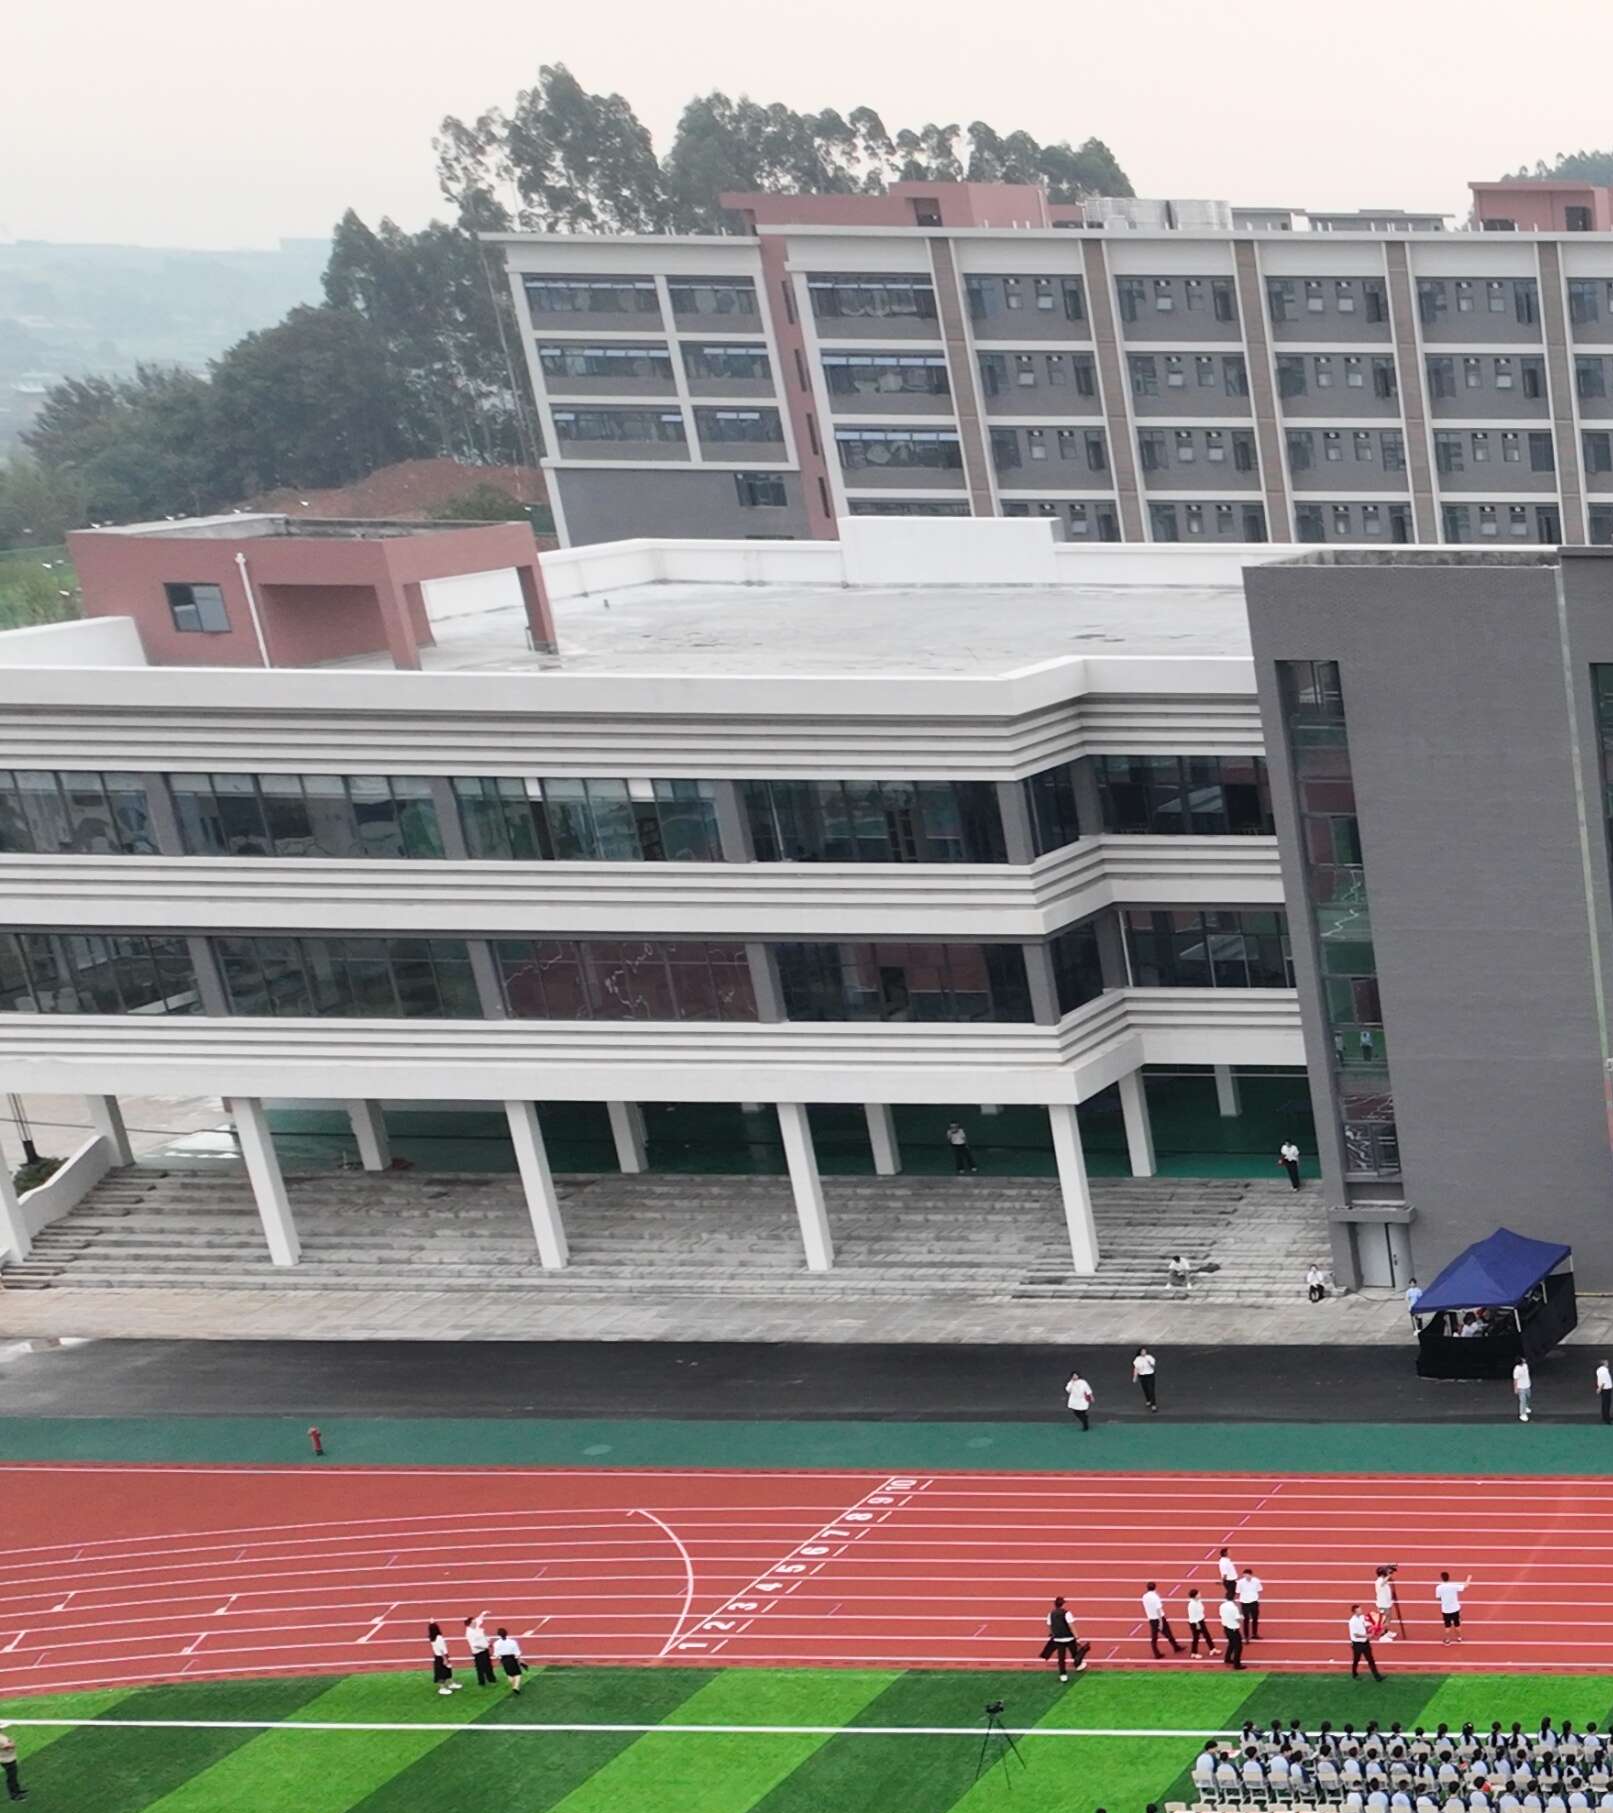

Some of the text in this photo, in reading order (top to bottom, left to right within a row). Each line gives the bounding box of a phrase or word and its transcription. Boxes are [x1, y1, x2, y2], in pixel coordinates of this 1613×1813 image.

[885, 1480, 917, 1491] 10
[845, 1513, 873, 1521] 8
[821, 1529, 850, 1537] 7
[800, 1546, 829, 1555] 6
[775, 1564, 807, 1573] 5
[755, 1582, 783, 1591] 4
[727, 1602, 758, 1611] 3
[702, 1621, 736, 1630] 2
[678, 1642, 708, 1650] 1
